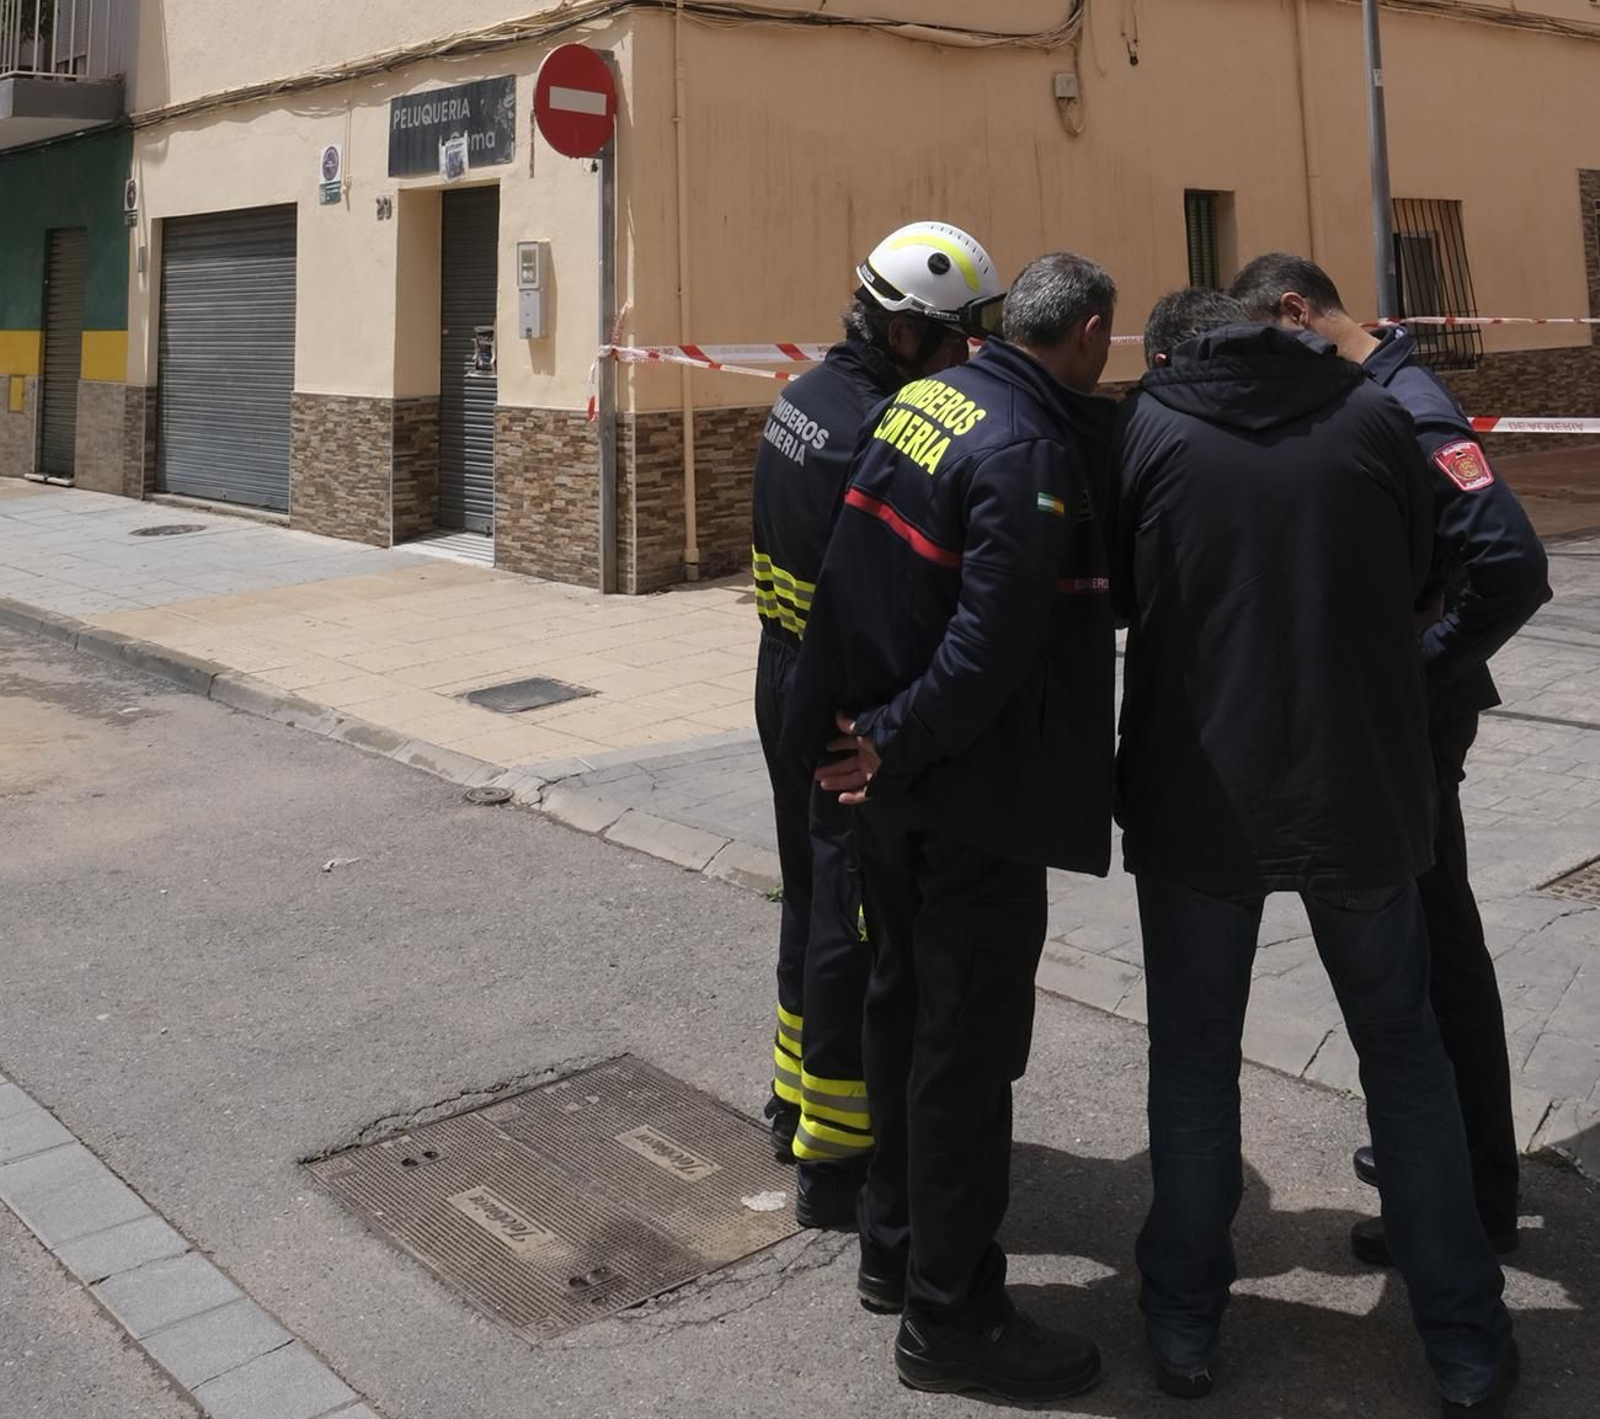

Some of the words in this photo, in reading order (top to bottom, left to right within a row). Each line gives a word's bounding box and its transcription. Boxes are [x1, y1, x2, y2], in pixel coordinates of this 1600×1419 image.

[394, 97, 471, 130] PELUQUERIA
[763, 416, 806, 467] LMERIA
[873, 407, 951, 475] LMERIA
